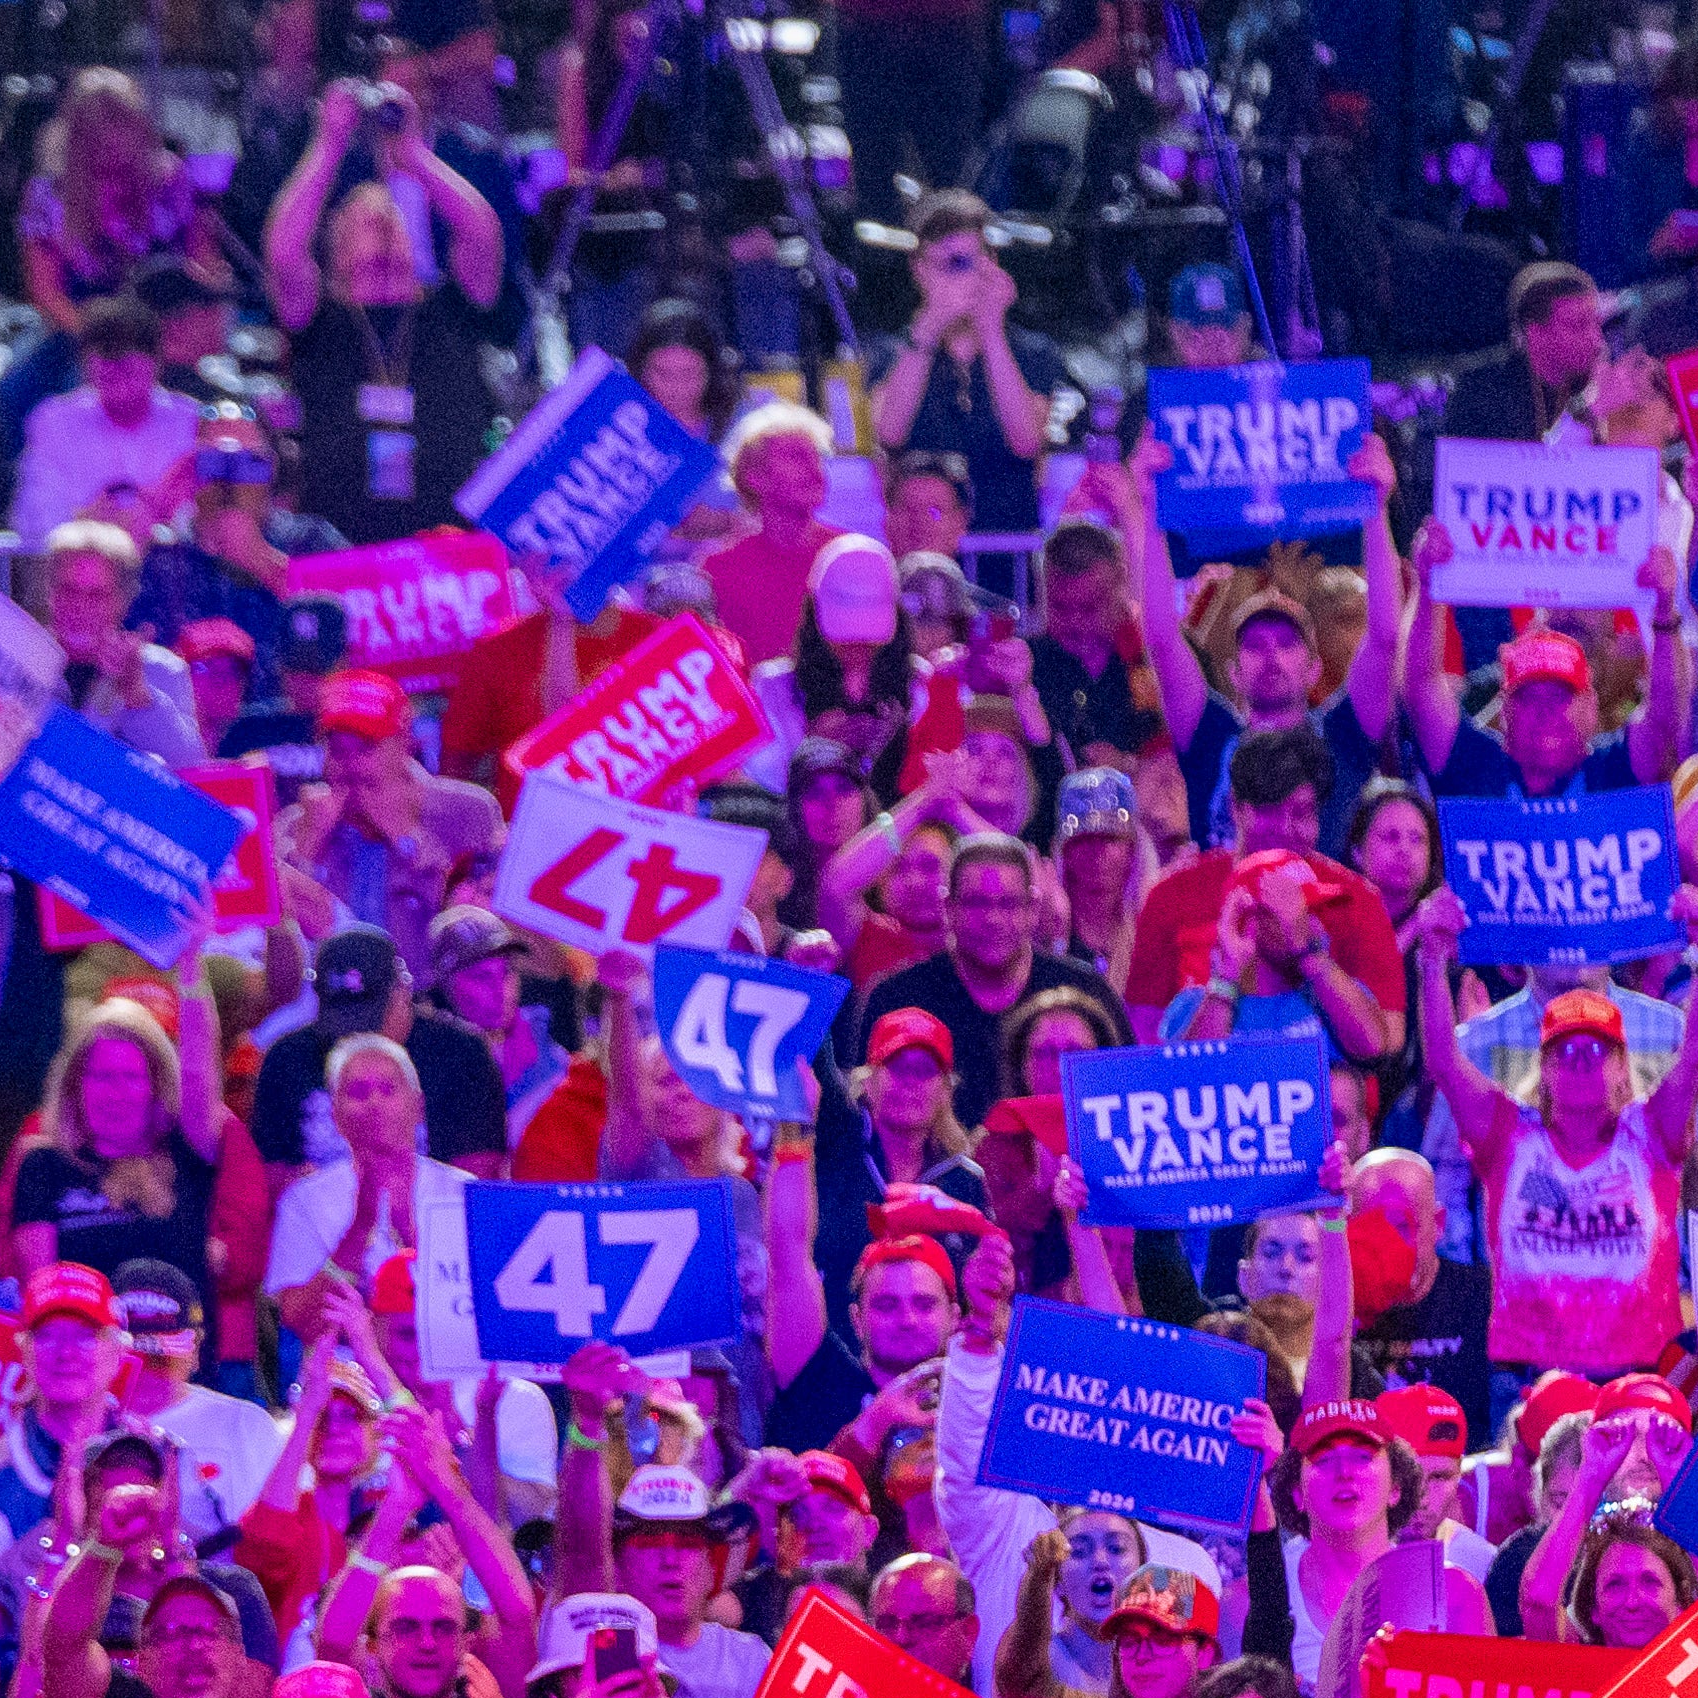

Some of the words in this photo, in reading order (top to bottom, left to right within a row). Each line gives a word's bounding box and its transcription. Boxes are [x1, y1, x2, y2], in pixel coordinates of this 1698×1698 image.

[1163, 399, 1359, 449] TRUMP
[506, 400, 653, 548] TRUMP
[1182, 436, 1340, 477] VANCE
[1456, 484, 1642, 523] TRUMP
[1471, 523, 1618, 554] VANCE
[1456, 828, 1663, 882] TRUMP
[528, 827, 721, 943] 47
[1488, 867, 1643, 911] VANCE
[672, 974, 810, 1099] 47
[1082, 1079, 1316, 1141] TRUMP
[1113, 1124, 1295, 1170] VANCE
[1146, 1170, 1207, 1186] AMERICA
[493, 1209, 700, 1338] 47
[1017, 1362, 1112, 1405] MAKE
[1116, 1380, 1243, 1429] AMERIC
[1024, 1404, 1122, 1450] GREAT
[1128, 1423, 1231, 1468] AGAIN
[1089, 1490, 1136, 1512] 2024
